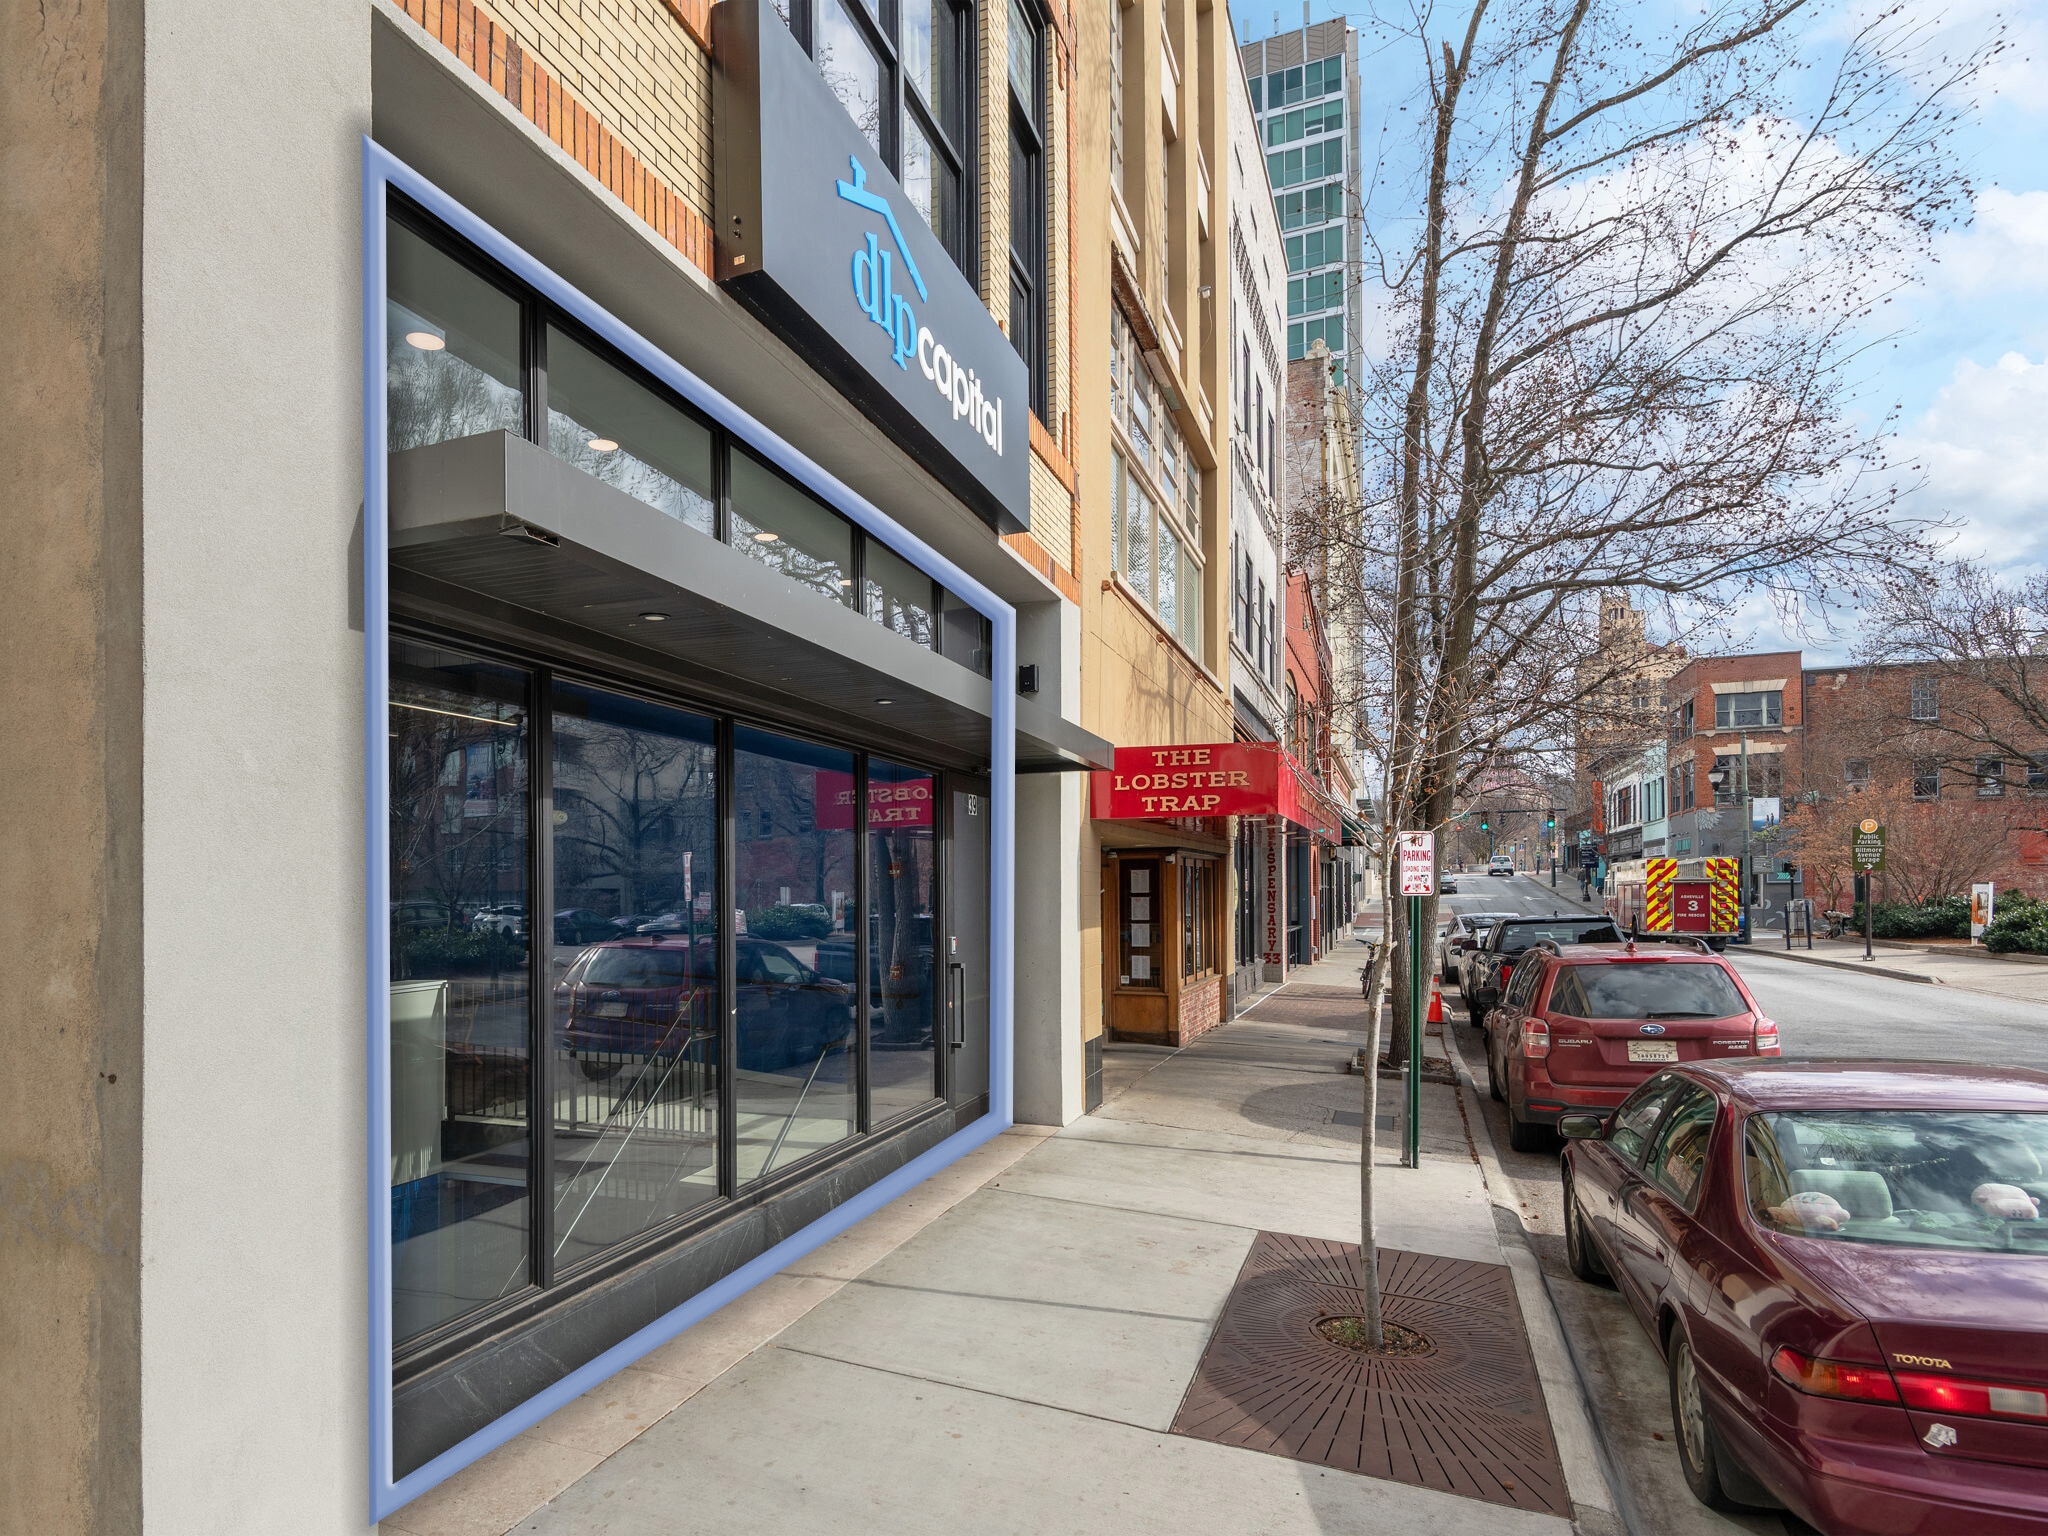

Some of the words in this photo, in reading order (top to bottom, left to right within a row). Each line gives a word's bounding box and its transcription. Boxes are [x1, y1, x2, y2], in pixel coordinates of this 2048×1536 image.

[852, 231, 918, 371] dlp
[918, 326, 1003, 457] capital
[1151, 748, 1211, 767] THE
[1114, 770, 1251, 791] LOBSTER
[1141, 794, 1221, 812] TRAP
[1865, 822, 1874, 831] P
[1403, 850, 1431, 861] PARKING
[1266, 828, 1277, 952] SPENSARY
[1687, 900, 1699, 911] 3
[1263, 952, 1281, 964] 33
[1892, 1353, 1953, 1369] TOYOTA
